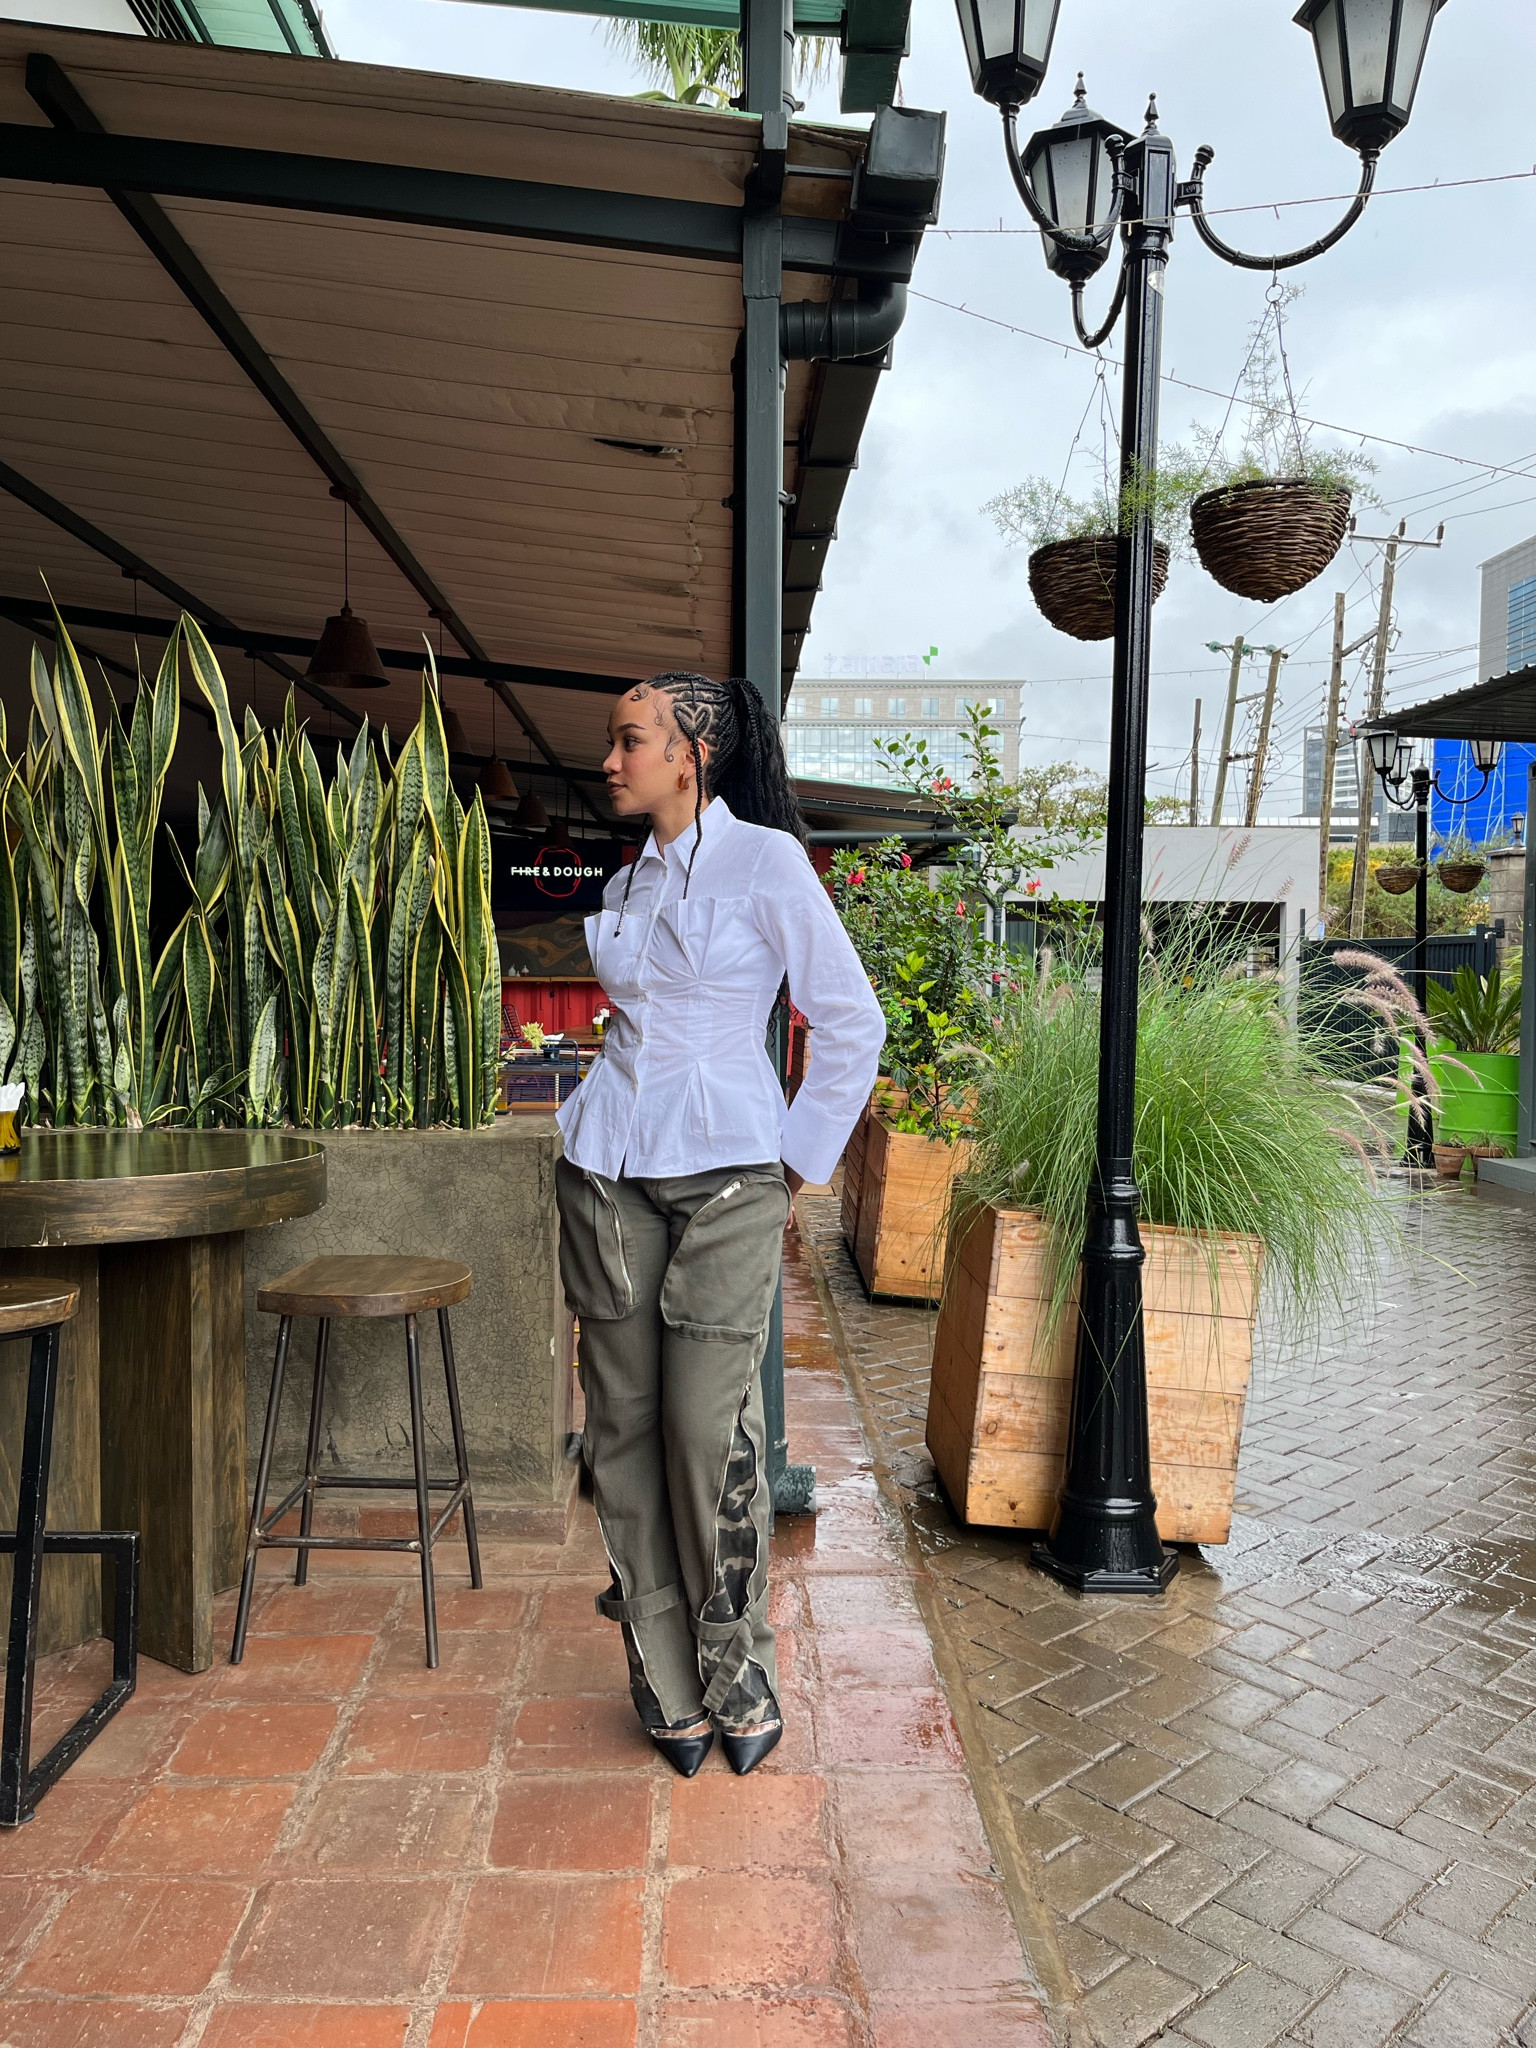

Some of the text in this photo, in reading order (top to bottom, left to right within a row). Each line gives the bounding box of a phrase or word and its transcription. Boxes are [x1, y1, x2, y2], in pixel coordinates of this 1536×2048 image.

[511, 866, 603, 877] FIRE & DOUGH
